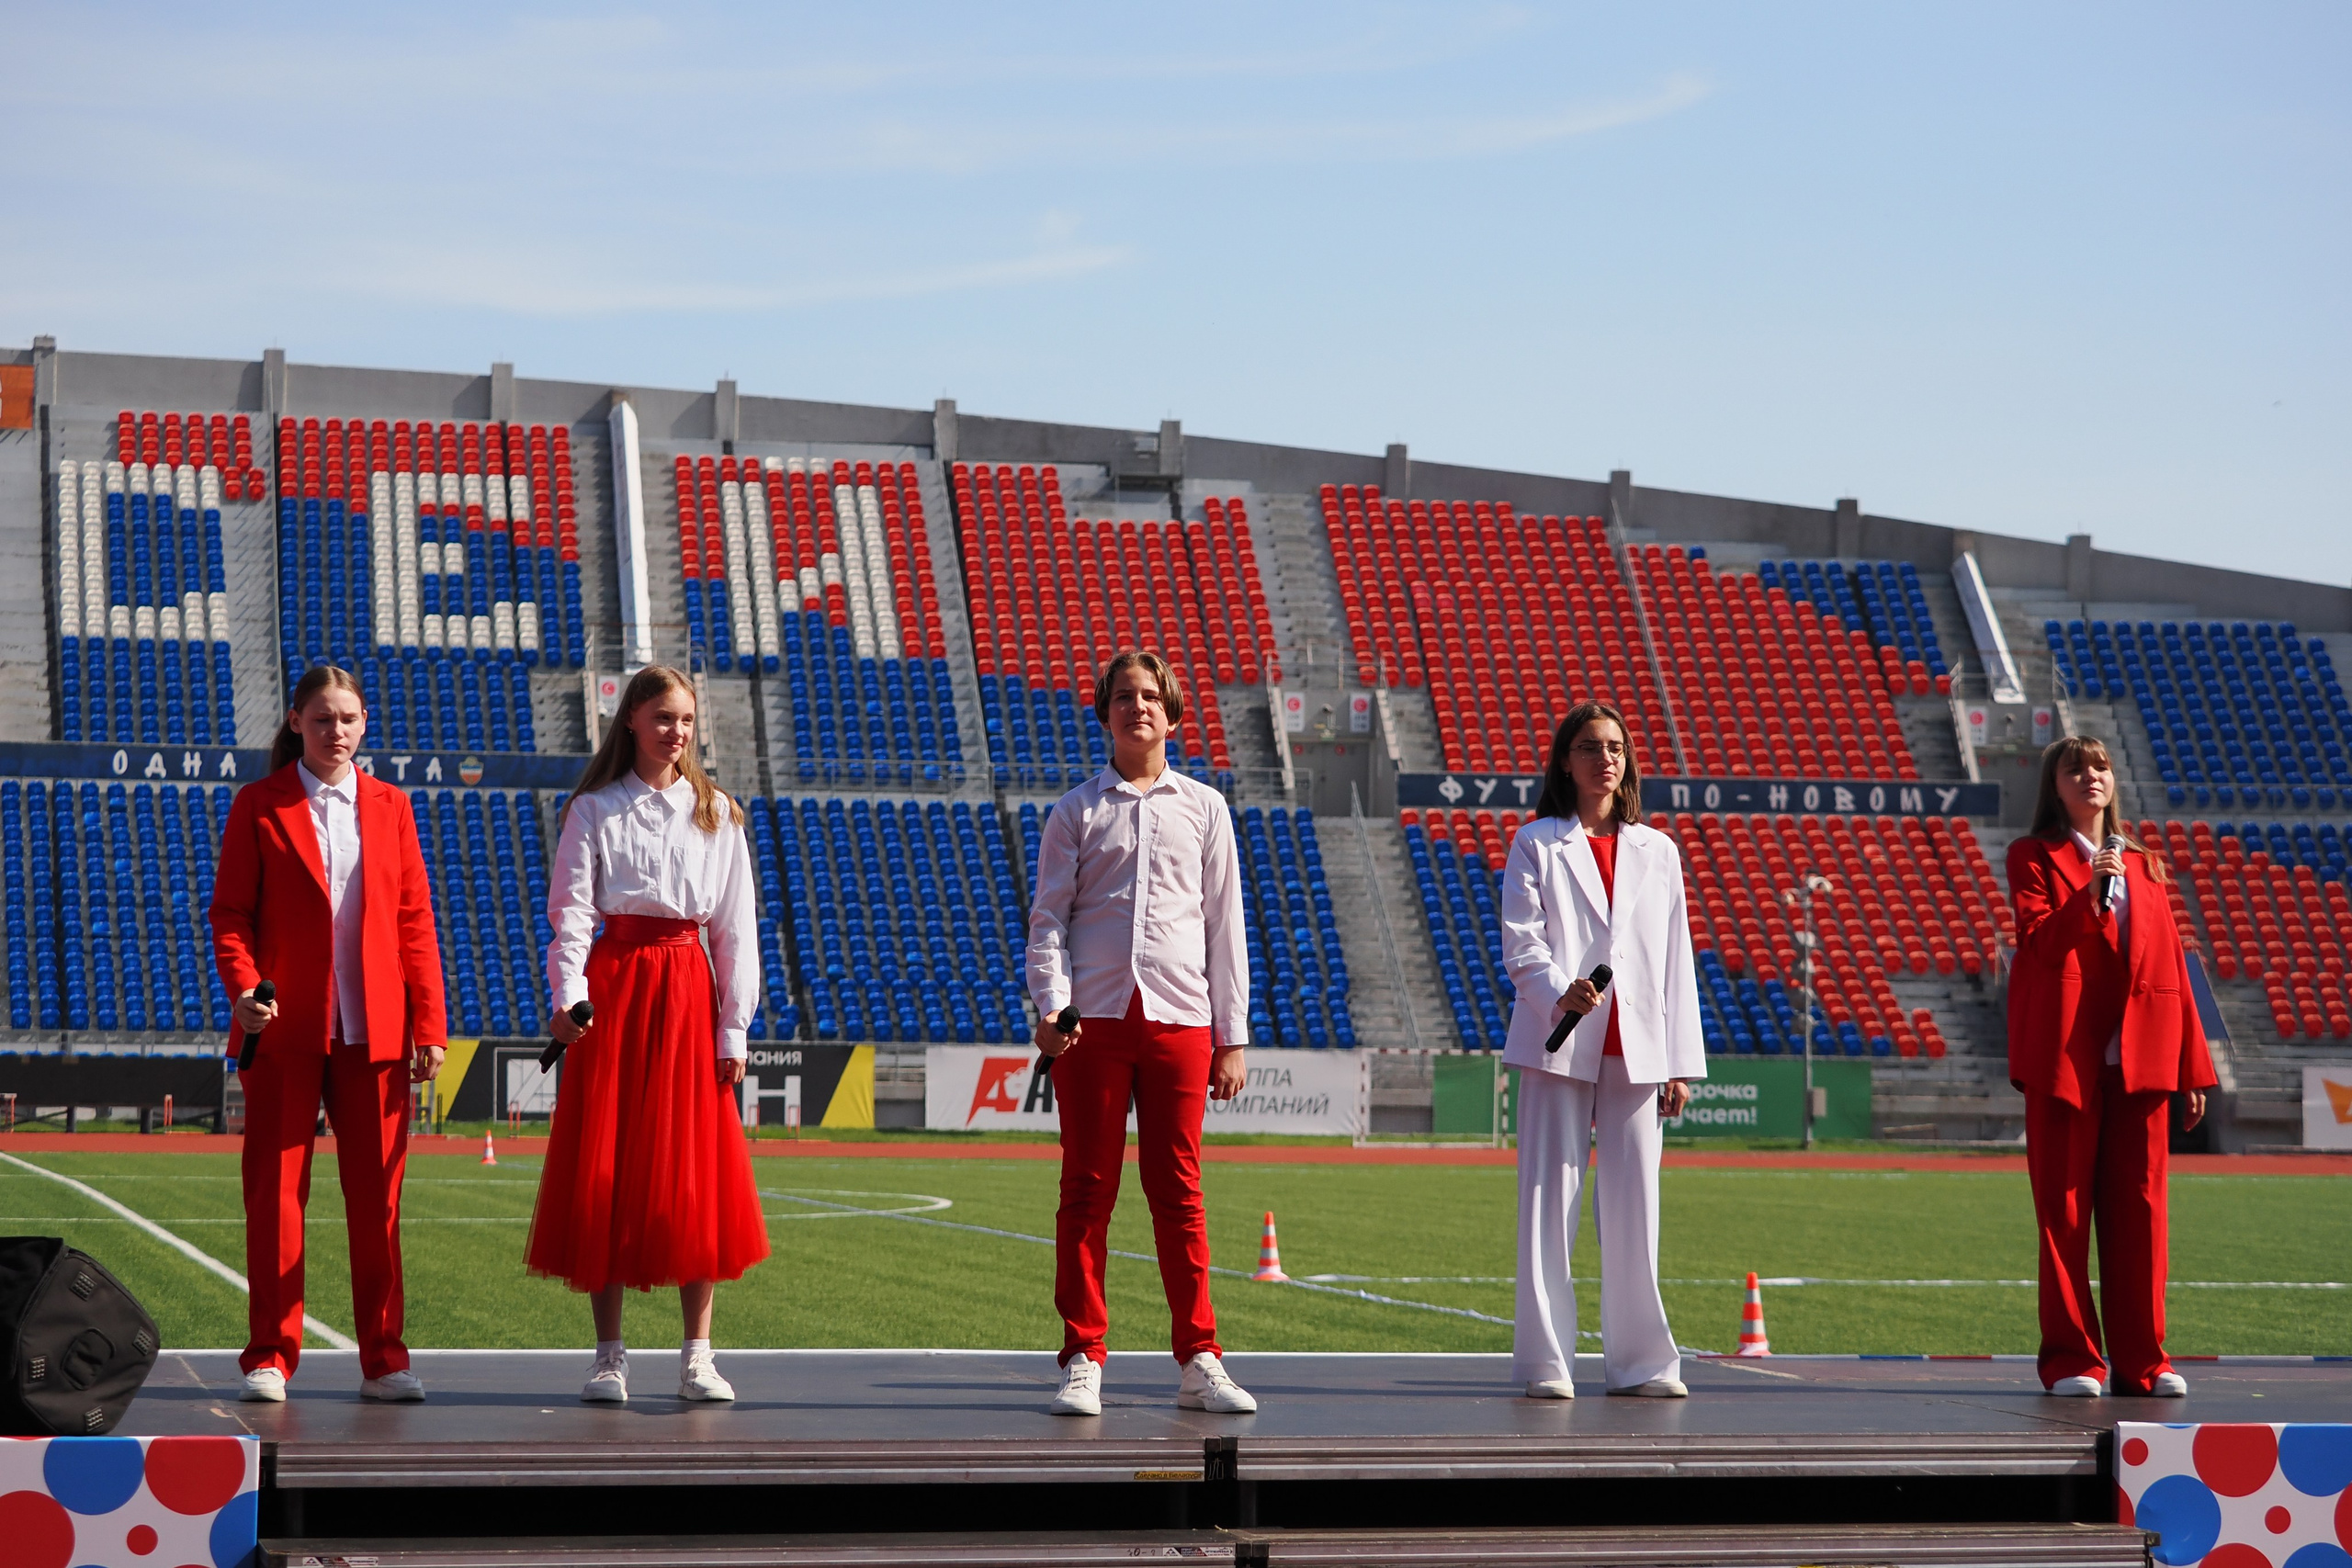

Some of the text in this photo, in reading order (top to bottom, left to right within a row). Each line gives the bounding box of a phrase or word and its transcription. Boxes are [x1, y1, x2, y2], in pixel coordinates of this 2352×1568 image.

[112, 749, 237, 779] ОДНА
[1438, 775, 1960, 814] ФУТ ПО-НОВОМУ
[1246, 1067, 1294, 1087] ППА
[1688, 1084, 1758, 1103] рочка
